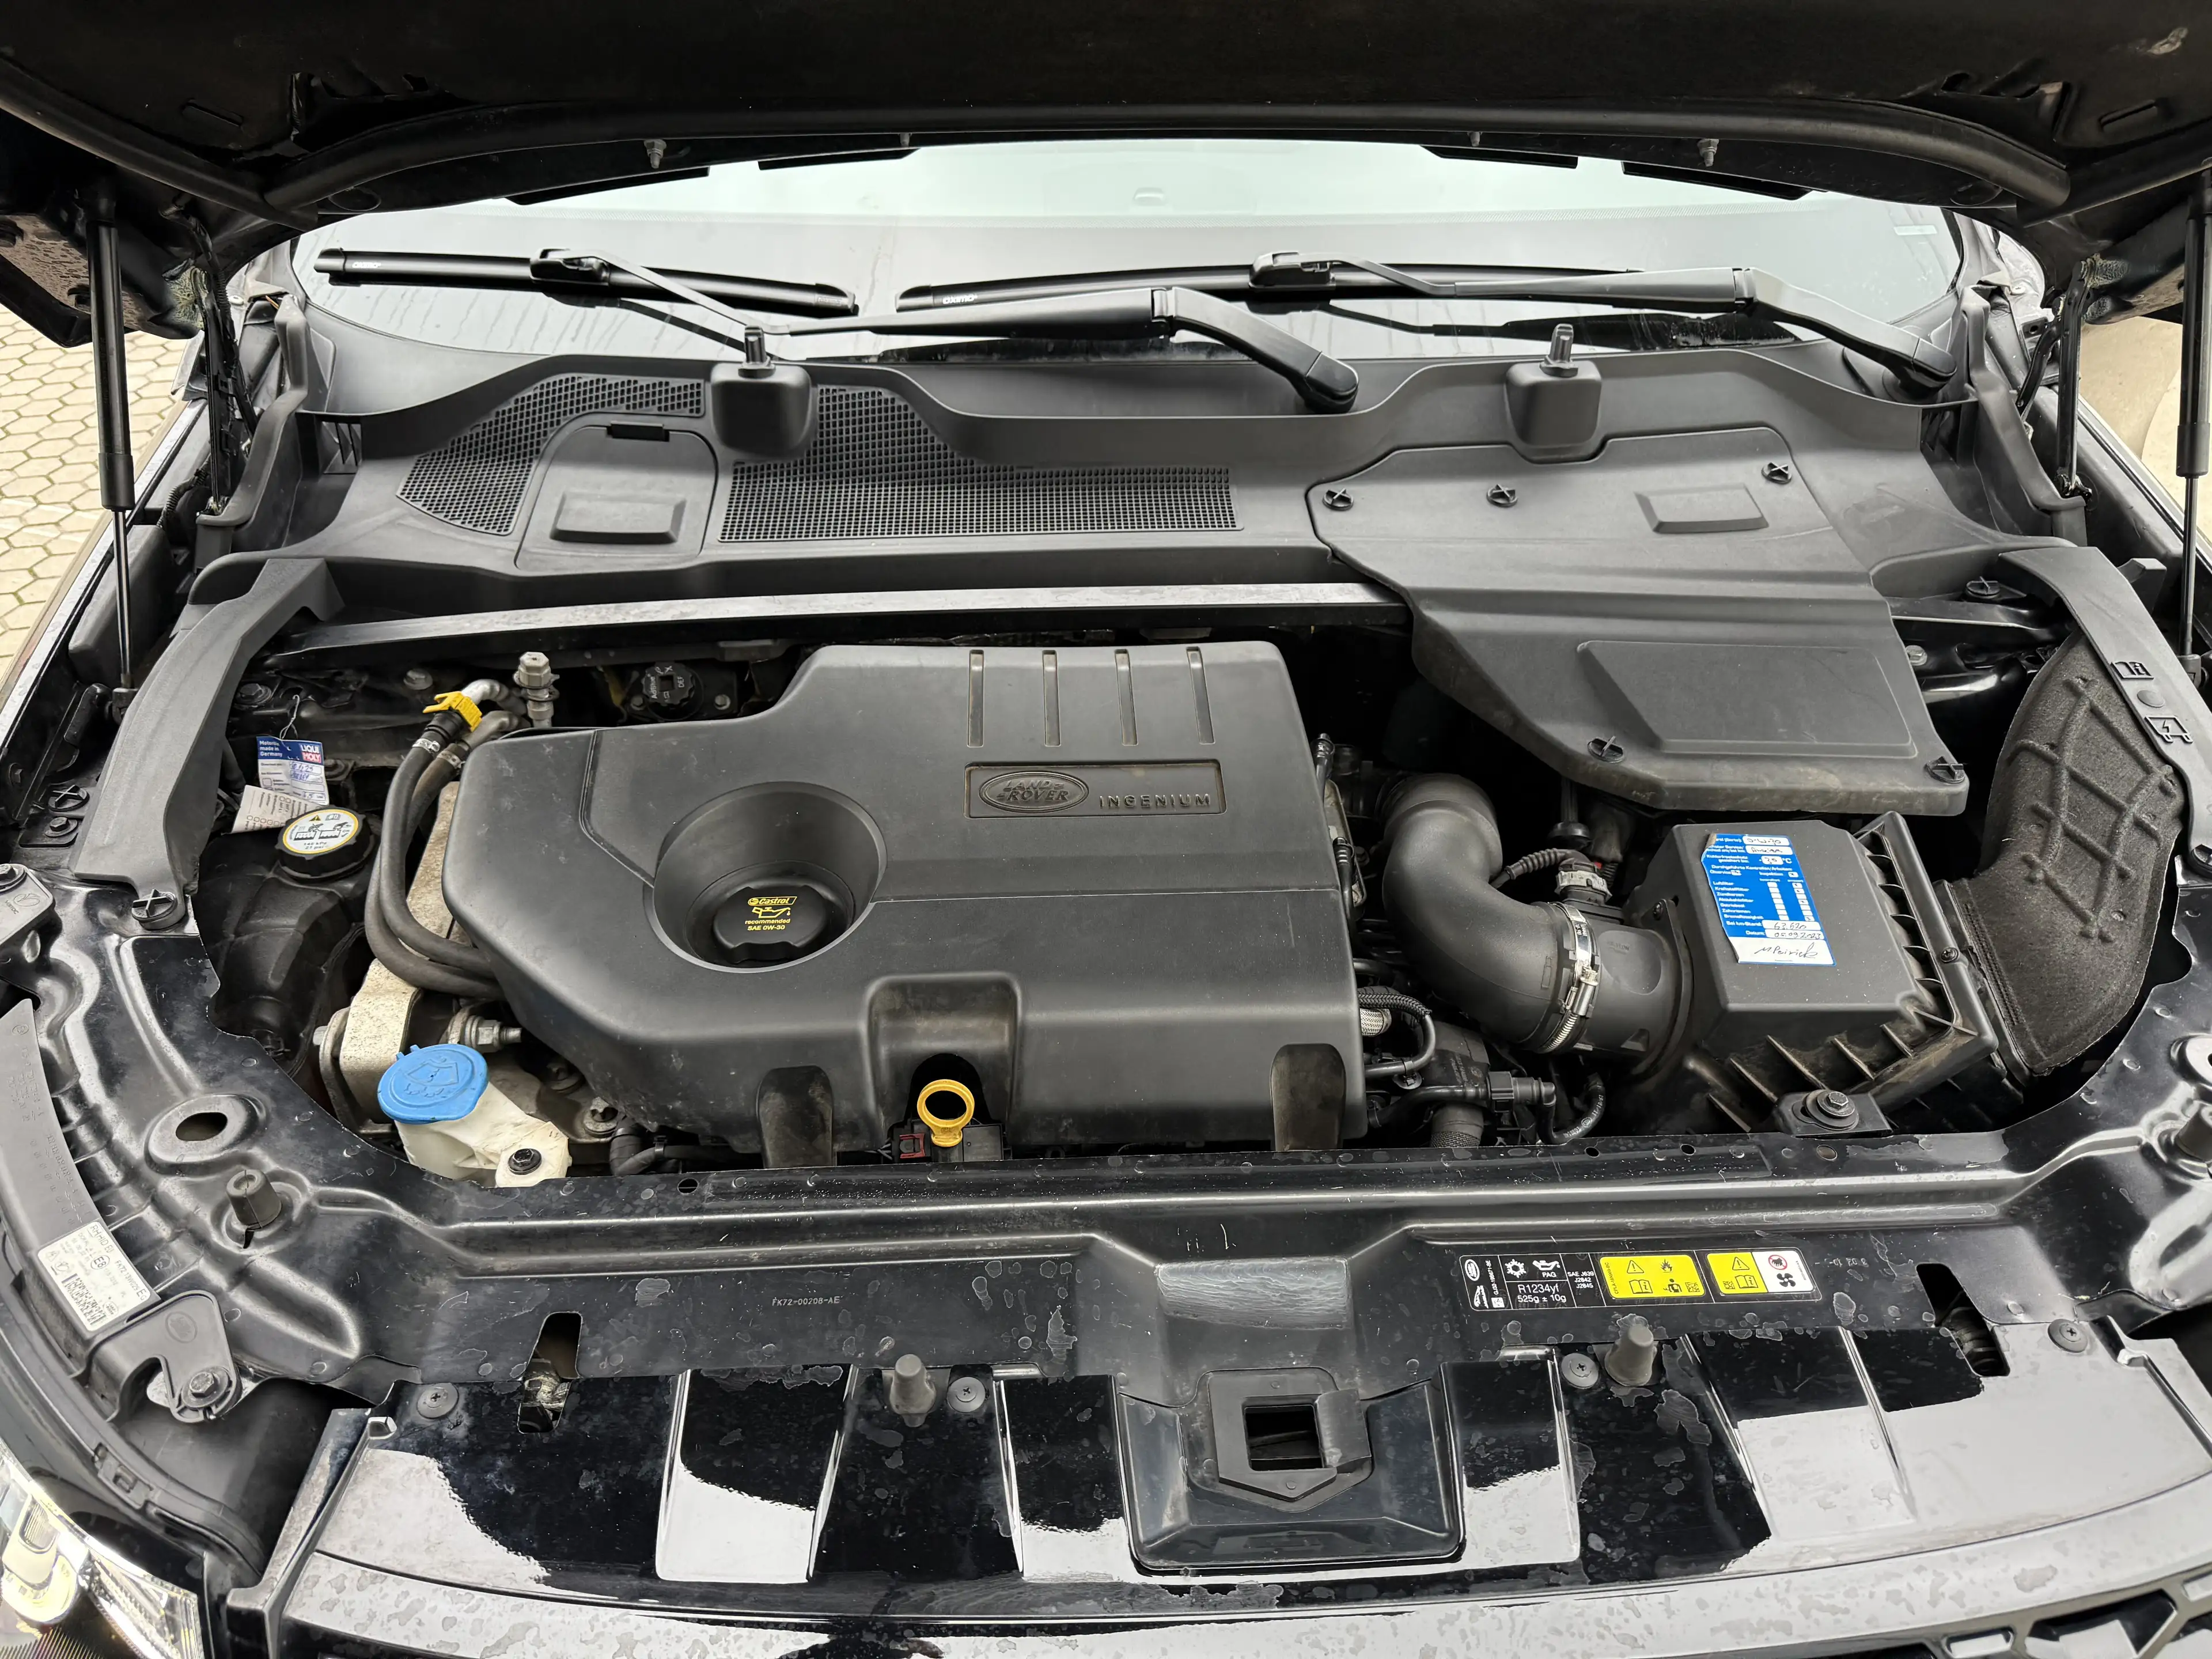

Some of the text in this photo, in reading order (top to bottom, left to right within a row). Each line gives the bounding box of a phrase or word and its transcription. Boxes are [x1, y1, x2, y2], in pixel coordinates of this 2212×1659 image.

[300, 744, 320, 753] LIQUI
[303, 752, 321, 762] MOLY
[1003, 780, 1052, 791] LAND
[1006, 790, 1069, 801] ROVER
[1099, 793, 1210, 808] INGENIUM
[93, 1256, 107, 1268] E8
[1517, 1283, 1559, 1294] R1234yf
[771, 1296, 840, 1306] FK72-00208-AE
[1517, 1294, 1540, 1304] 525g
[1550, 1294, 1567, 1303] 10g
